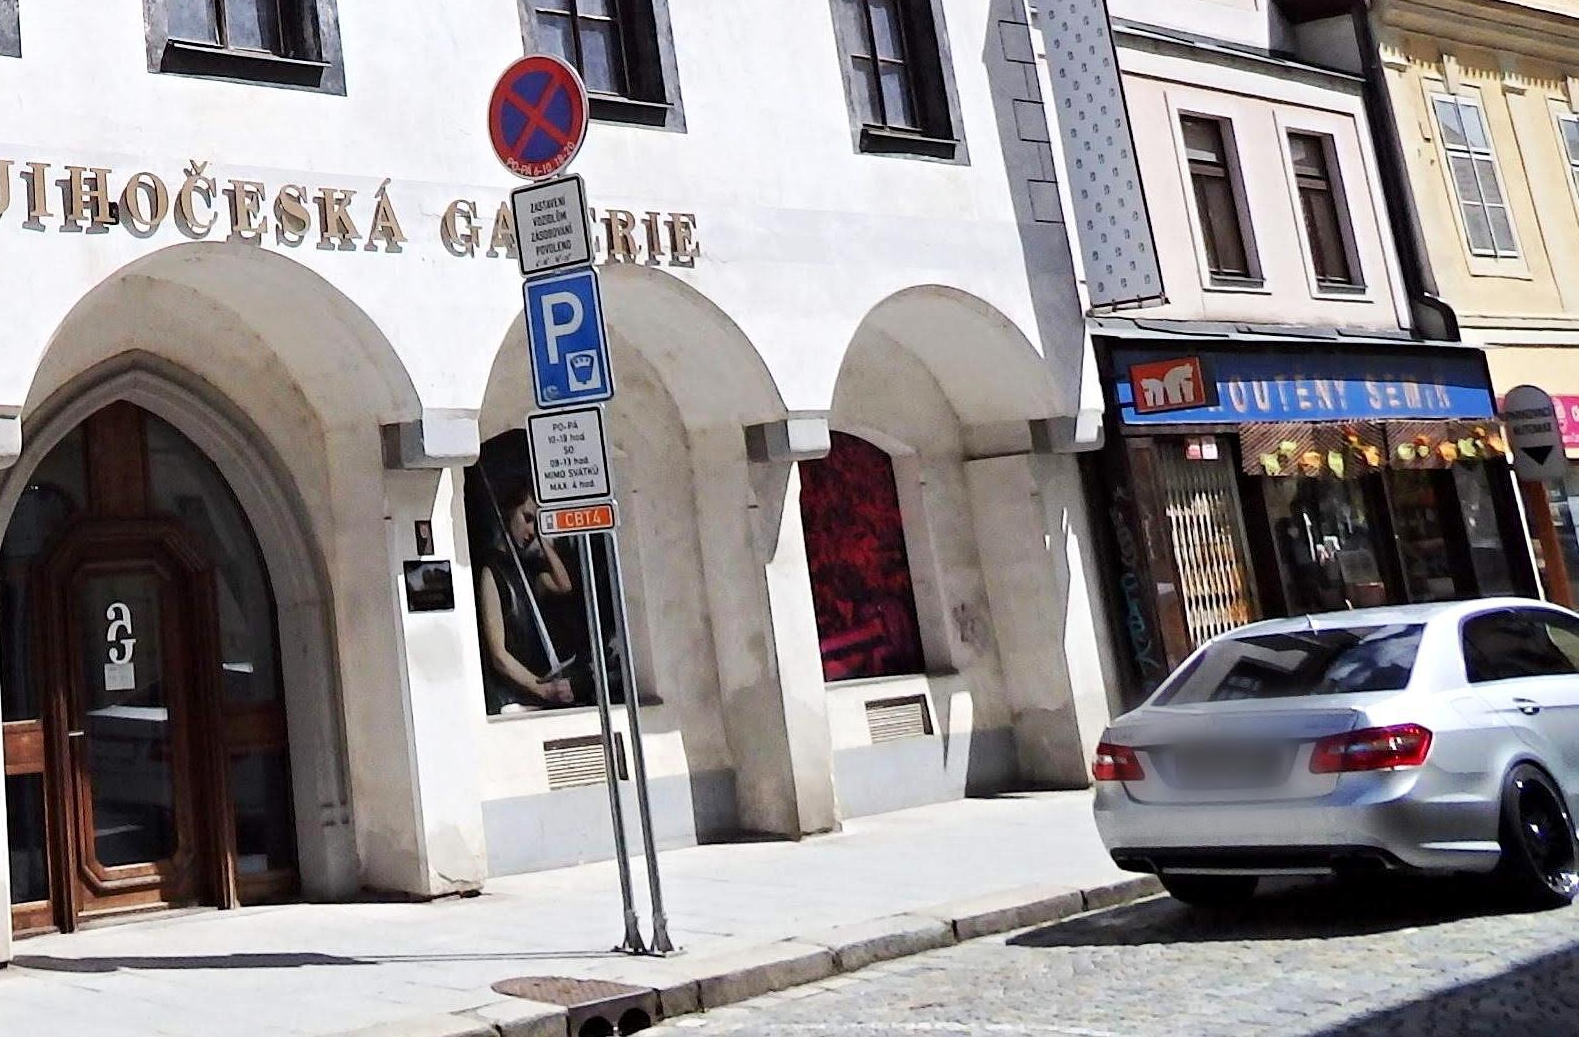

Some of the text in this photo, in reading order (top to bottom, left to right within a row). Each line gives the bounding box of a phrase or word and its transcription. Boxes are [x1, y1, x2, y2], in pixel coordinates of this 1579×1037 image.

[440, 198, 700, 261] GARIE
[541, 291, 584, 365] P
[565, 509, 602, 527] CBT4
